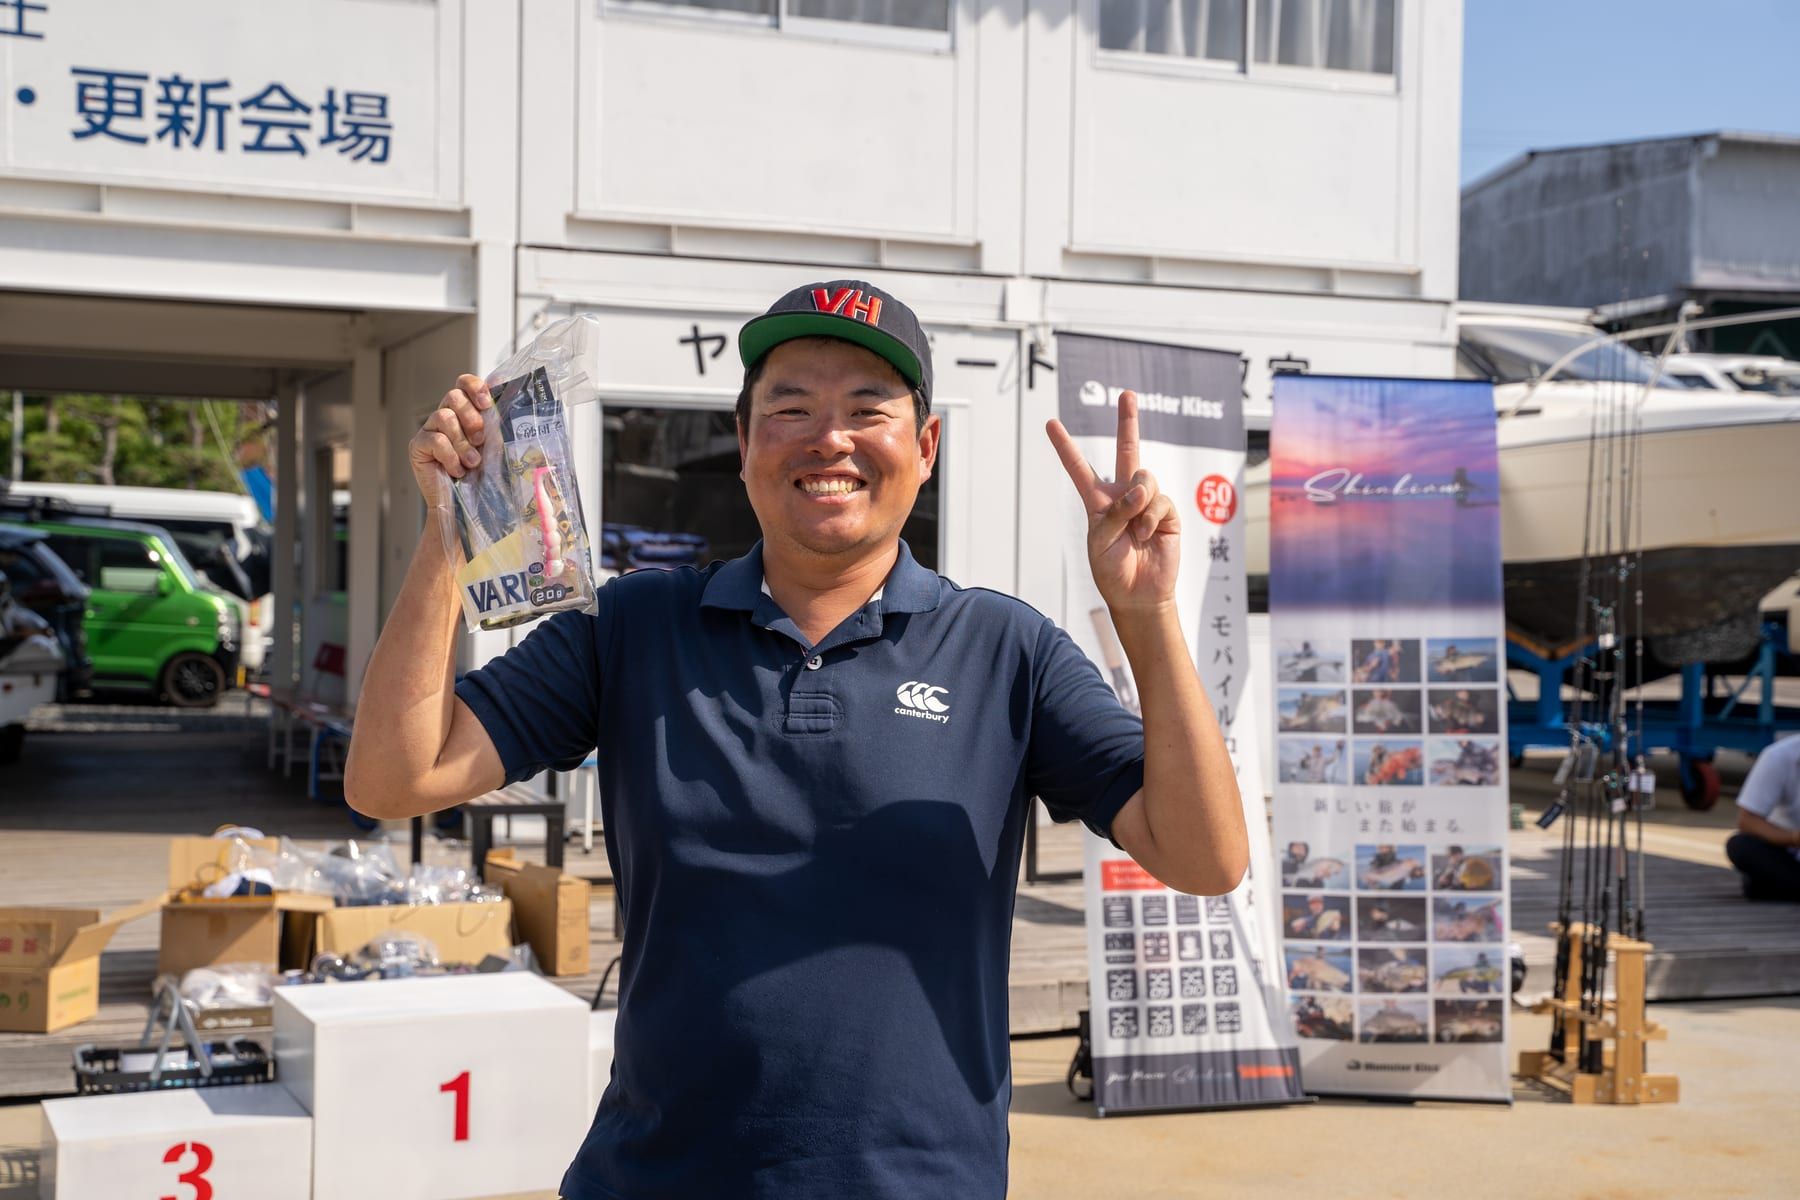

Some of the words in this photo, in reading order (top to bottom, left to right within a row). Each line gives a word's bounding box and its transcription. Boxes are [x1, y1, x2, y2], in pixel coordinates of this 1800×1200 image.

[812, 287, 882, 327] VH
[1108, 386, 1181, 415] Mnster
[1182, 395, 1224, 420] Kiss
[1200, 480, 1232, 507] 50
[535, 589, 563, 602] 20g
[894, 707, 950, 724] canterbury
[439, 1070, 472, 1142] 1
[159, 1141, 214, 1200] 3
